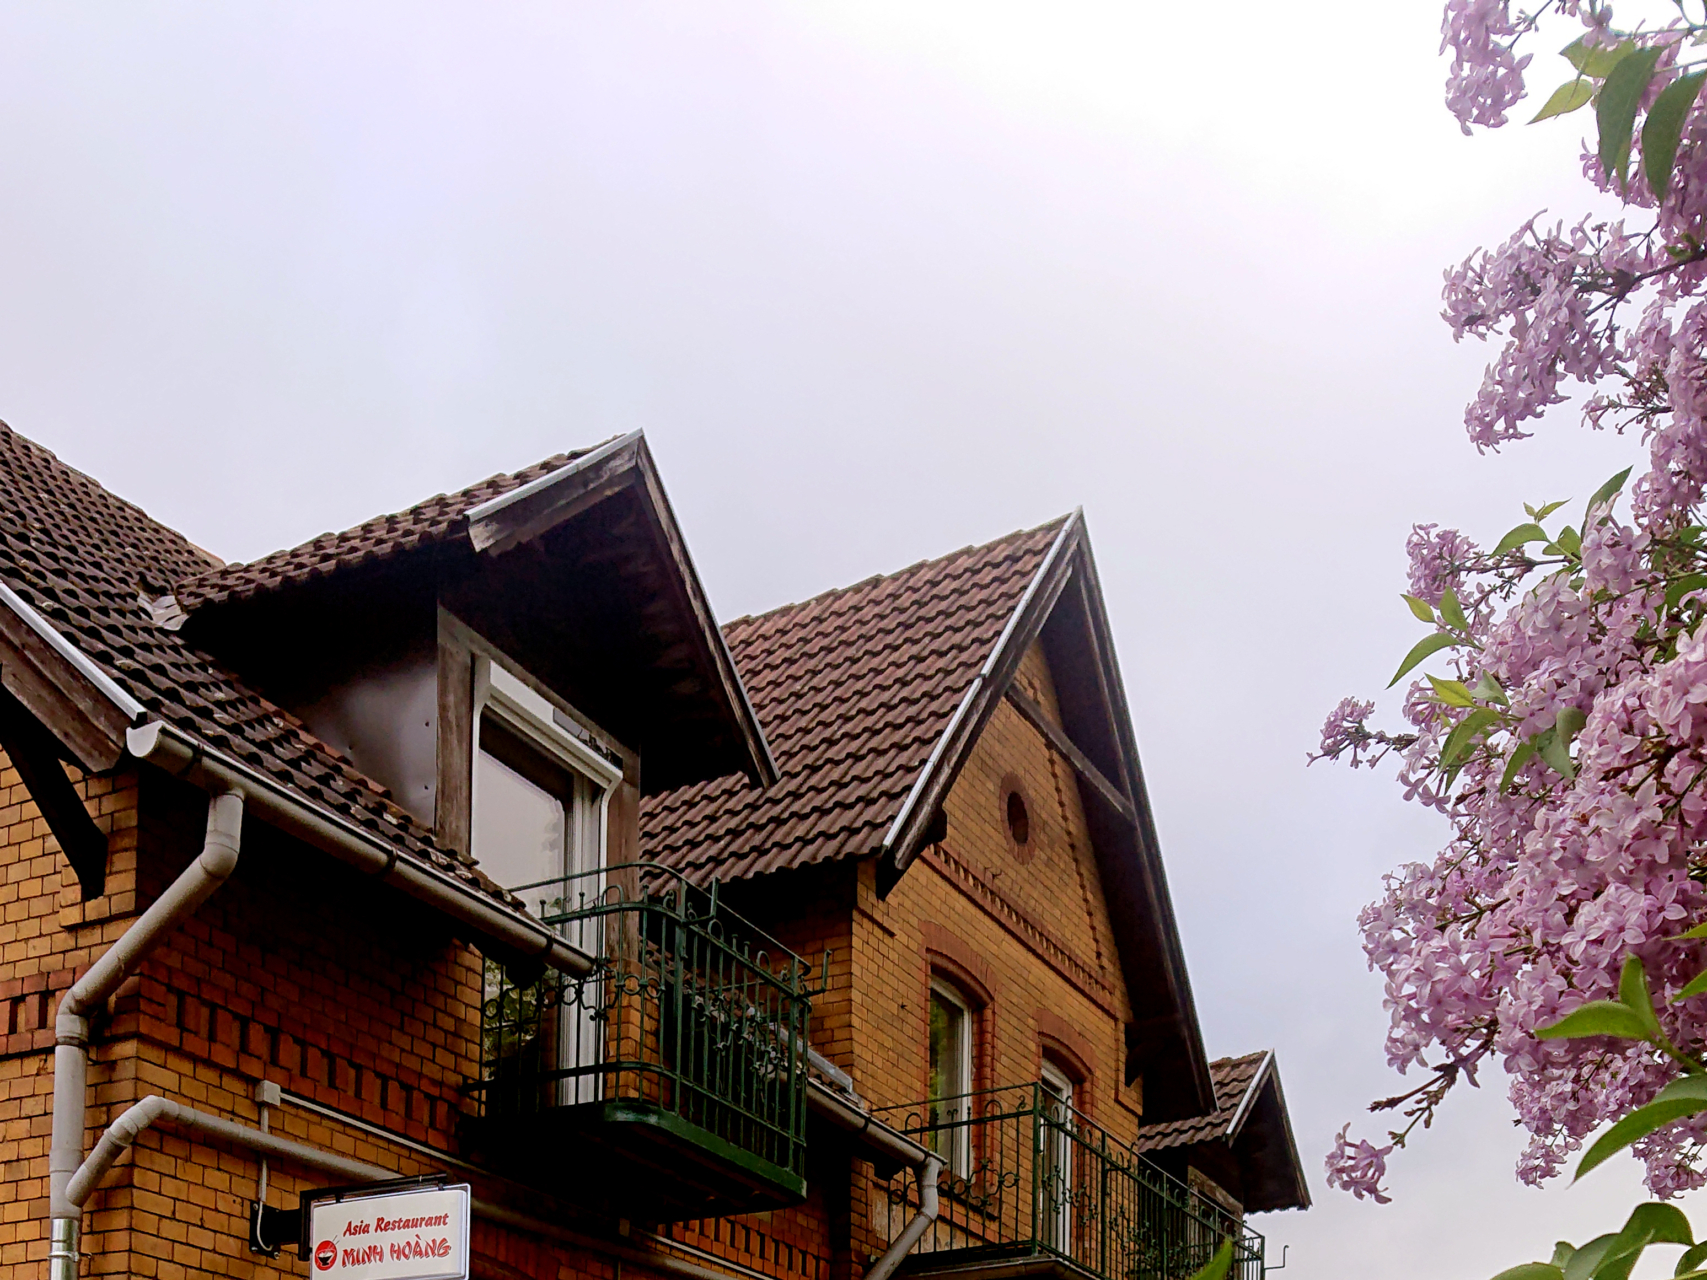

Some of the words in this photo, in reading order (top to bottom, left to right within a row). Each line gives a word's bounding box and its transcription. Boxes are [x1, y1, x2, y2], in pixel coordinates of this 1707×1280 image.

[343, 1219, 370, 1237] Asia
[374, 1213, 449, 1233] Restaurant
[341, 1243, 384, 1268] MINH
[389, 1234, 452, 1262] HOÀNG
